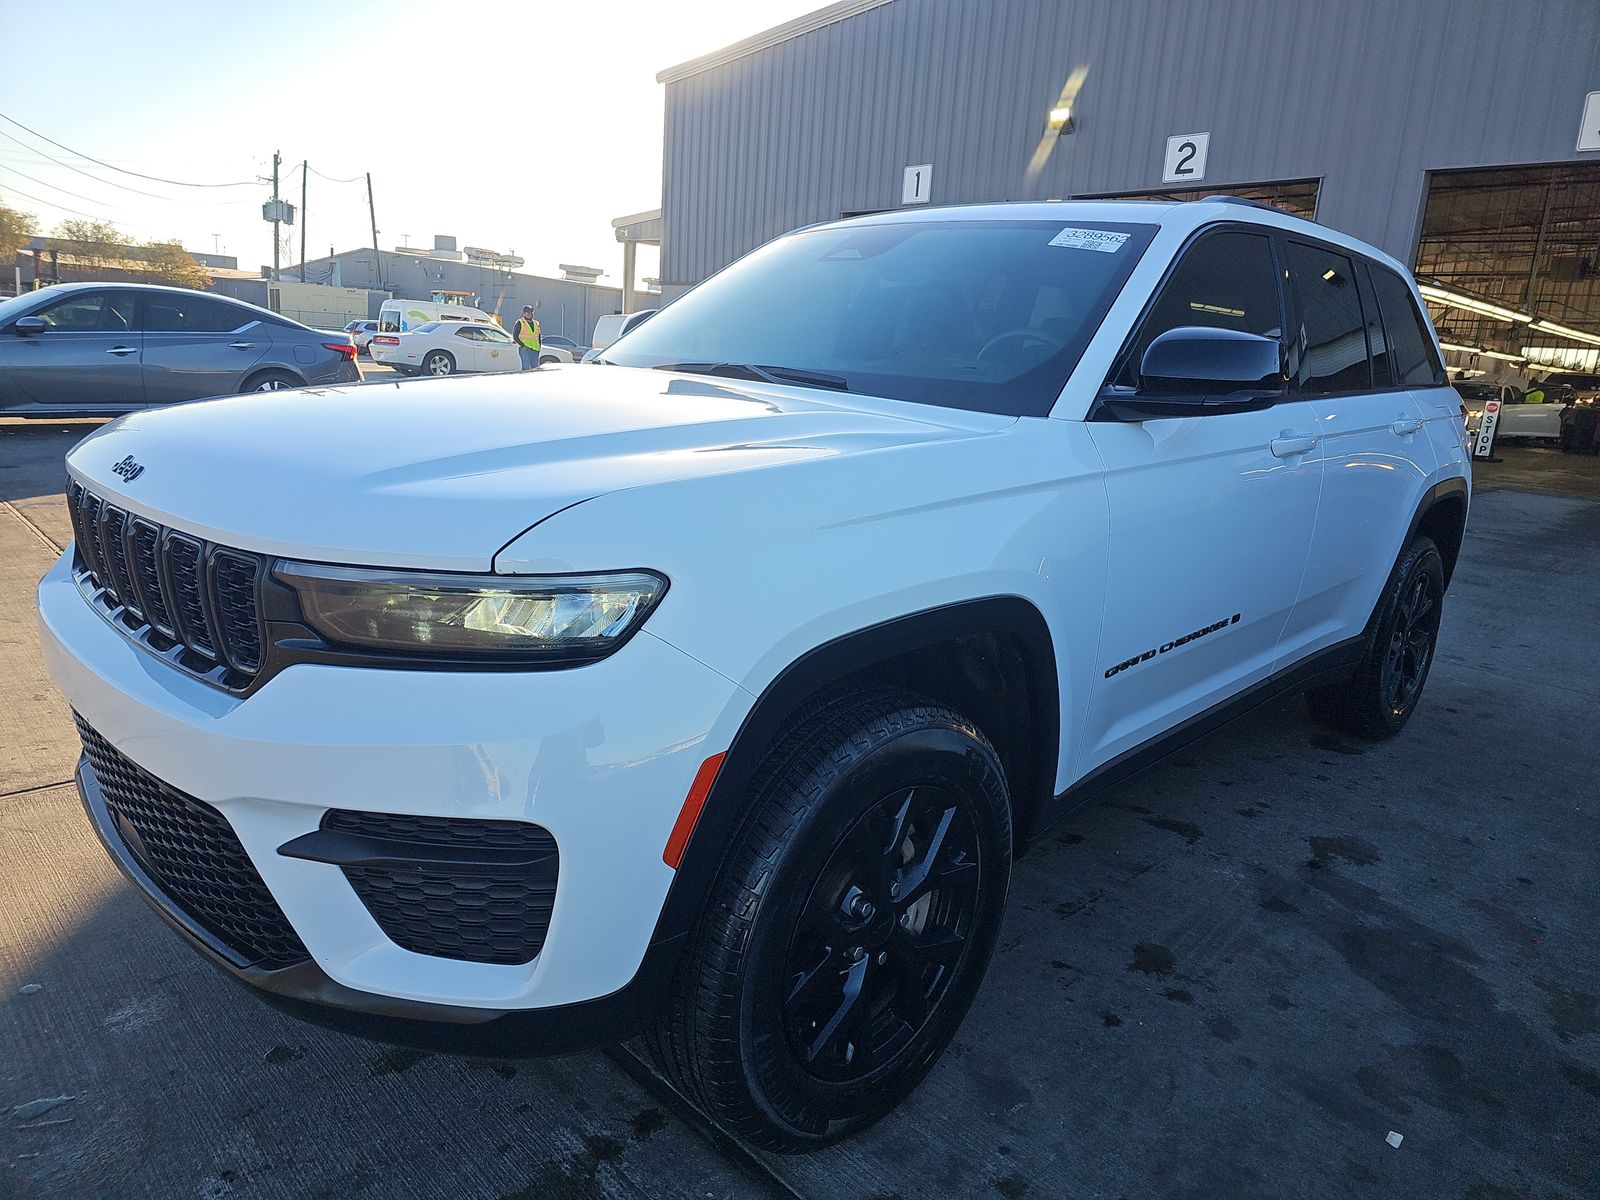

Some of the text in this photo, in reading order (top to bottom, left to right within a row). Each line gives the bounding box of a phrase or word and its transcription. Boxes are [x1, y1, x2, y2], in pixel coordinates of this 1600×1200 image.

[1174, 142, 1197, 175] 2
[914, 171, 921, 197] 1
[1067, 230, 1129, 243] 3289562
[1478, 415, 1494, 453] STOP
[112, 454, 145, 483] Jeep
[1105, 617, 1230, 679] GRAND CHEROKEE
